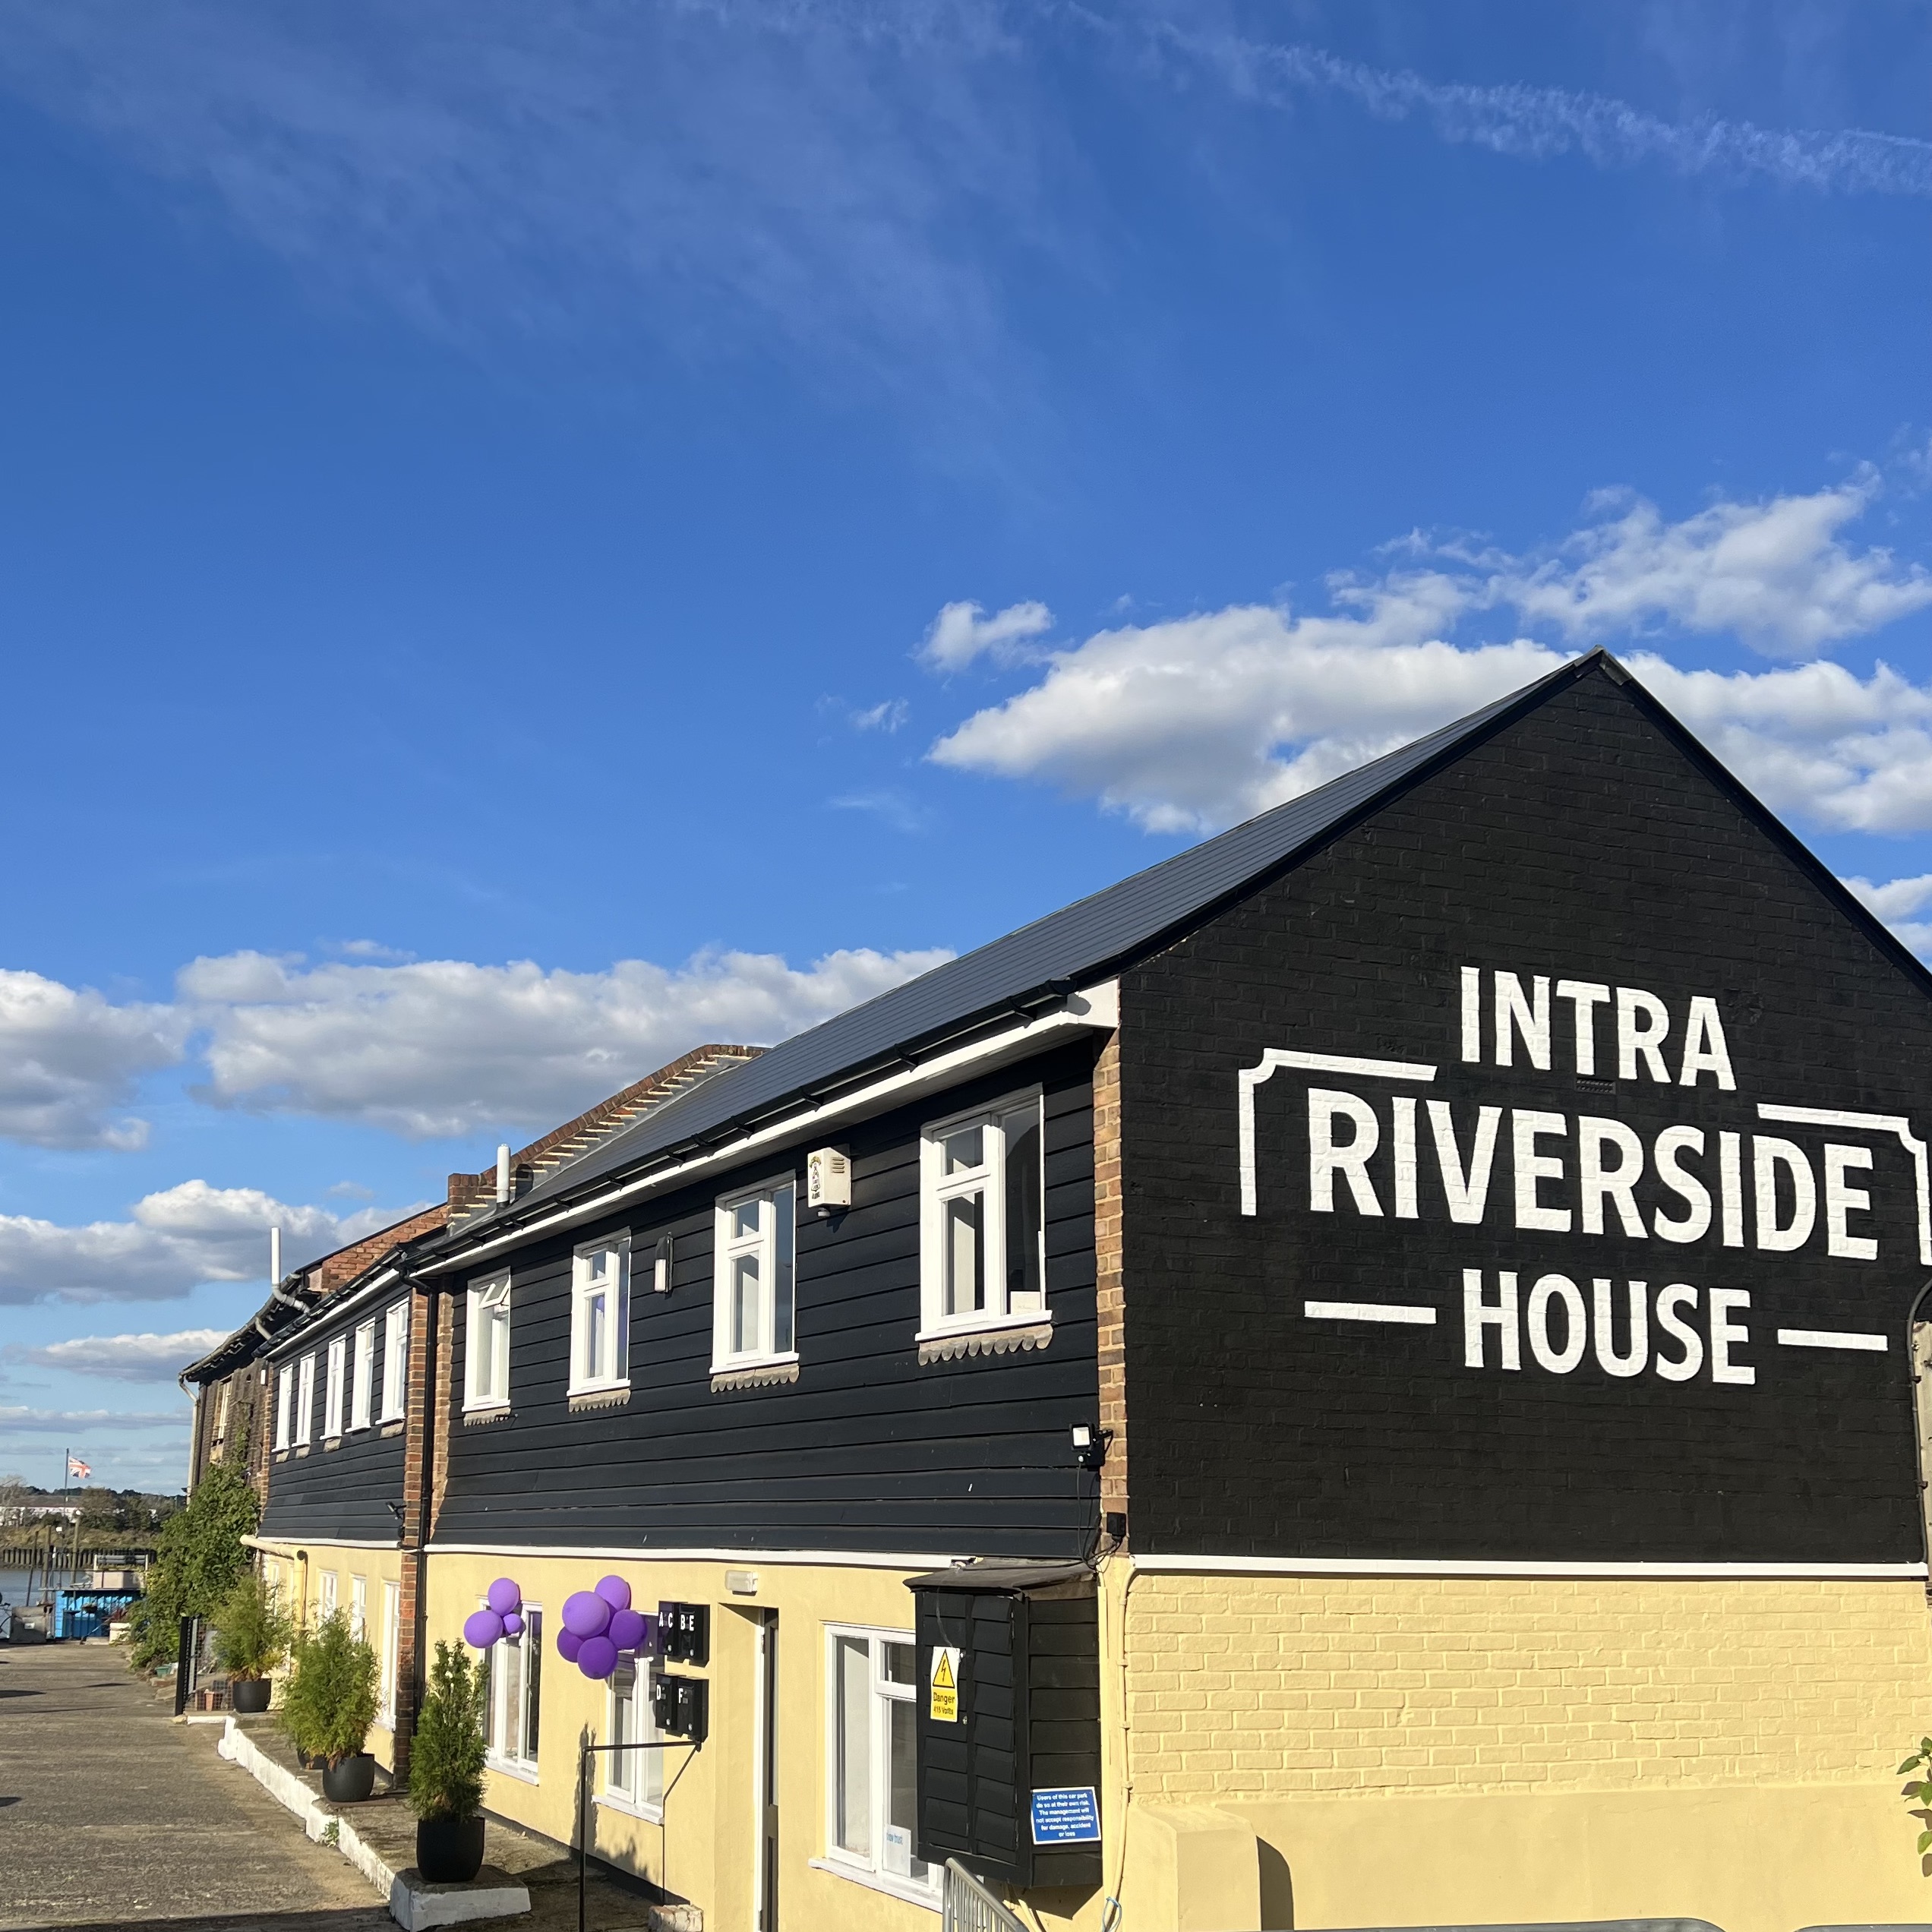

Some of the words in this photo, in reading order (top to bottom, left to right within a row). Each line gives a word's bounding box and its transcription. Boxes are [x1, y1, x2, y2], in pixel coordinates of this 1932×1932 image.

[1461, 967, 1736, 1090] INTRA
[1309, 1088, 1877, 1260] RIVERSIDE
[1463, 1269, 1755, 1384] HOUSE
[659, 1612, 664, 1627] A
[668, 1612, 674, 1628] C
[680, 1614, 686, 1631] B
[690, 1615, 695, 1631] E
[656, 1684, 661, 1700] D
[678, 1687, 683, 1704] F
[933, 1692, 955, 1705] Danger
